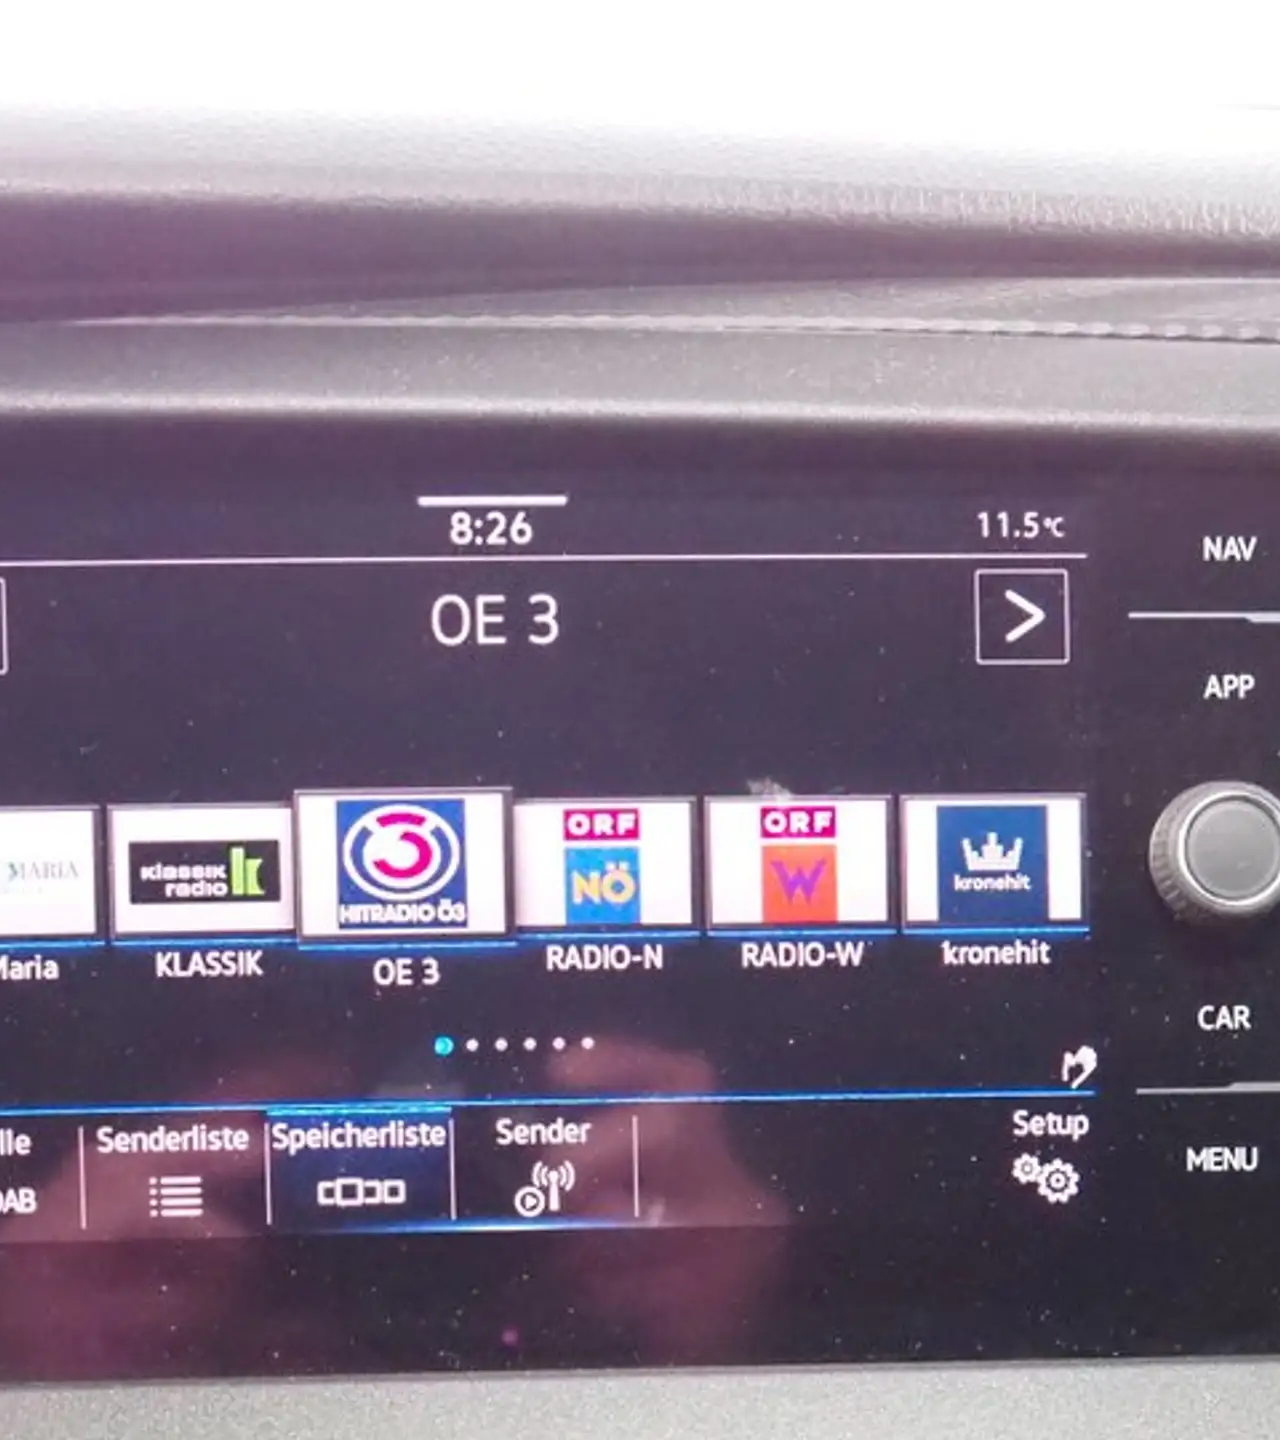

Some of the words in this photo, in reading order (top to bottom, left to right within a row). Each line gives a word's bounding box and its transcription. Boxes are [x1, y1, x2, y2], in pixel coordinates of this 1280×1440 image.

[449, 512, 534, 546] 8:26
[1203, 535, 1257, 561] NAV
[431, 594, 507, 647] OE
[528, 593, 559, 645] 3
[1203, 673, 1255, 699] APP
[567, 813, 636, 836] ORF
[764, 811, 835, 834] ORF
[164, 880, 228, 898] radio
[572, 860, 637, 905] NÖ
[770, 857, 826, 905] W
[953, 872, 1032, 891] kronehit
[339, 903, 435, 924] HITRADIO
[155, 949, 264, 978] KLASSIK
[546, 943, 663, 971] RADIO-N
[741, 940, 865, 968] RADIO-W
[940, 938, 1051, 965] kronehit
[373, 957, 413, 986] OE
[421, 956, 441, 985] 3
[1197, 1004, 1252, 1031] CAR
[96, 1123, 250, 1154] Senderliste
[271, 1119, 447, 1156] Speicherliste
[495, 1117, 593, 1145] Sender
[1012, 1109, 1090, 1142] Setup
[1186, 1146, 1258, 1172] MENU
